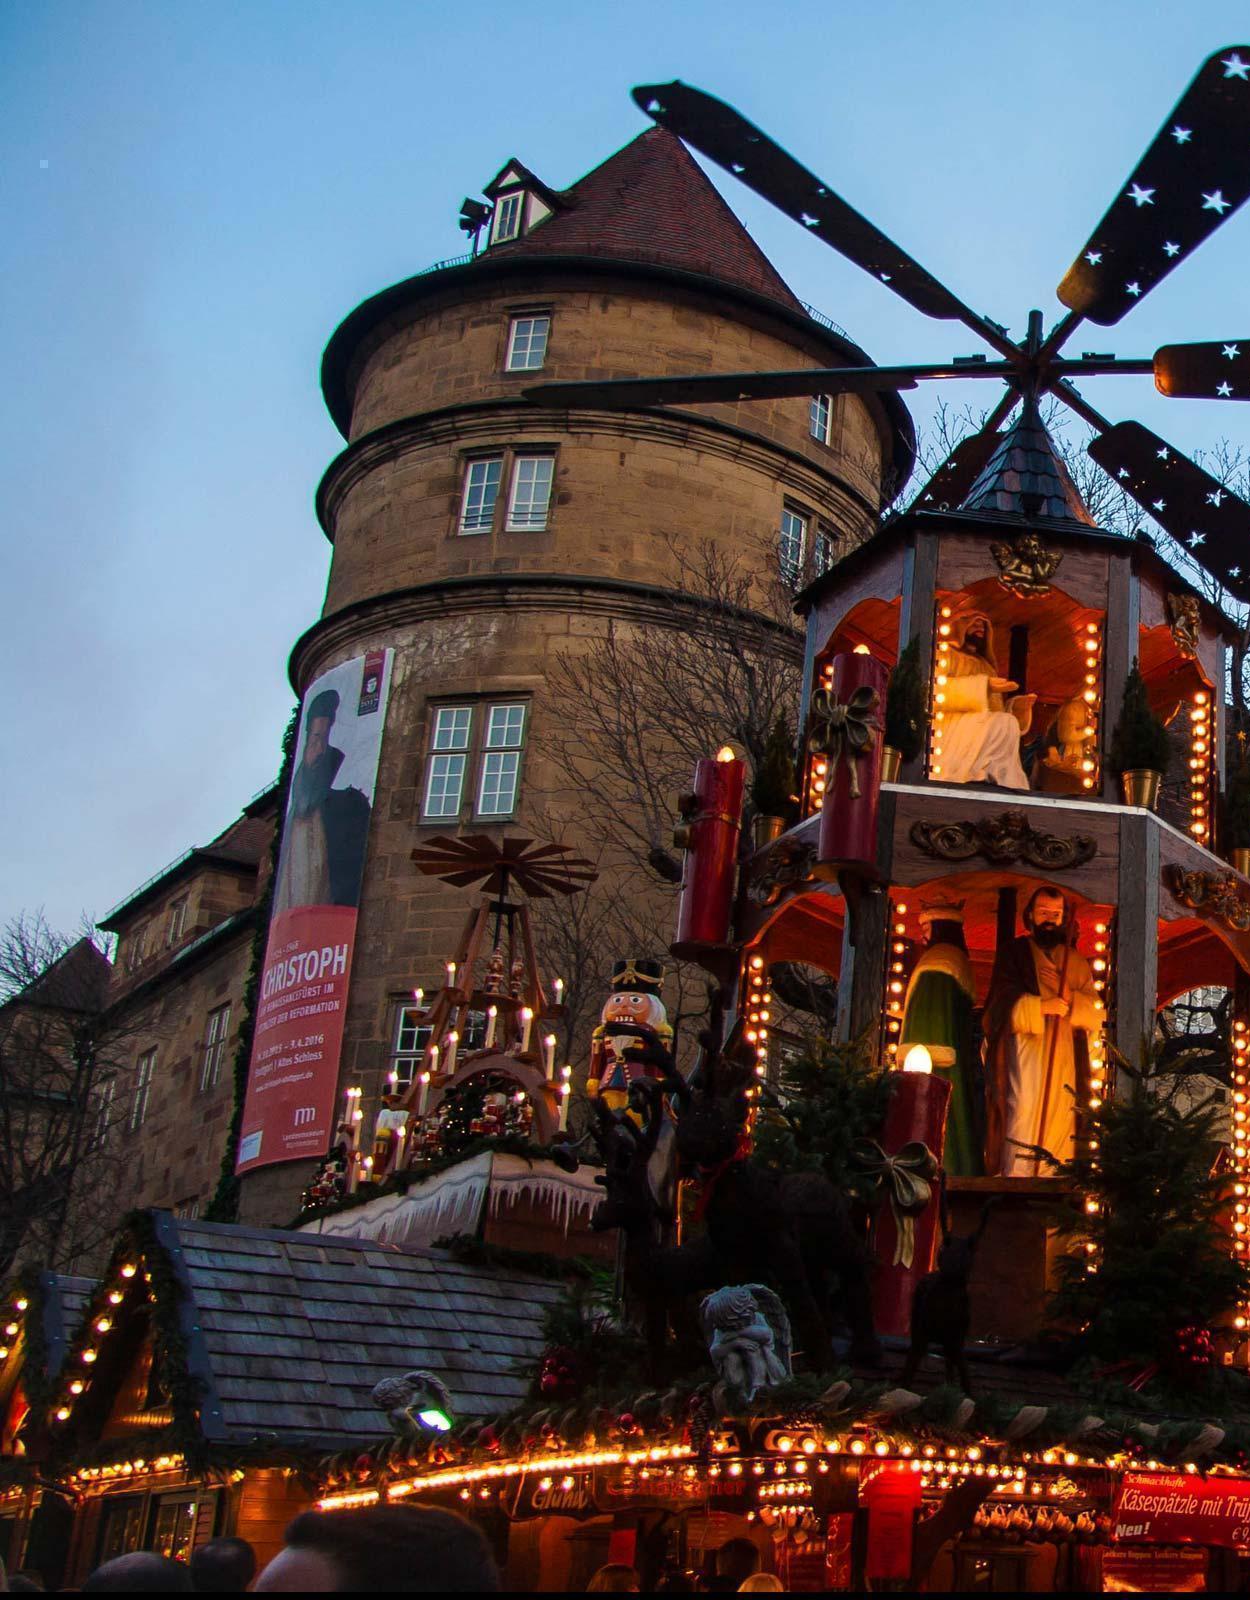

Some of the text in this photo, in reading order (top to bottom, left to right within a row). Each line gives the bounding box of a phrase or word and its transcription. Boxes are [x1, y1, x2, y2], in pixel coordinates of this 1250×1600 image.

[262, 943, 348, 1000] CHRISTOPH
[324, 983, 334, 994] IM
[289, 1000, 340, 1020] REFORMATION
[294, 1050, 323, 1064] Schloss
[1126, 1473, 1187, 1489] Schmackhafte
[1118, 1487, 1198, 1518] Käsespätzle
[1200, 1495, 1223, 1517] mit
[1115, 1521, 1151, 1538] Neu!
